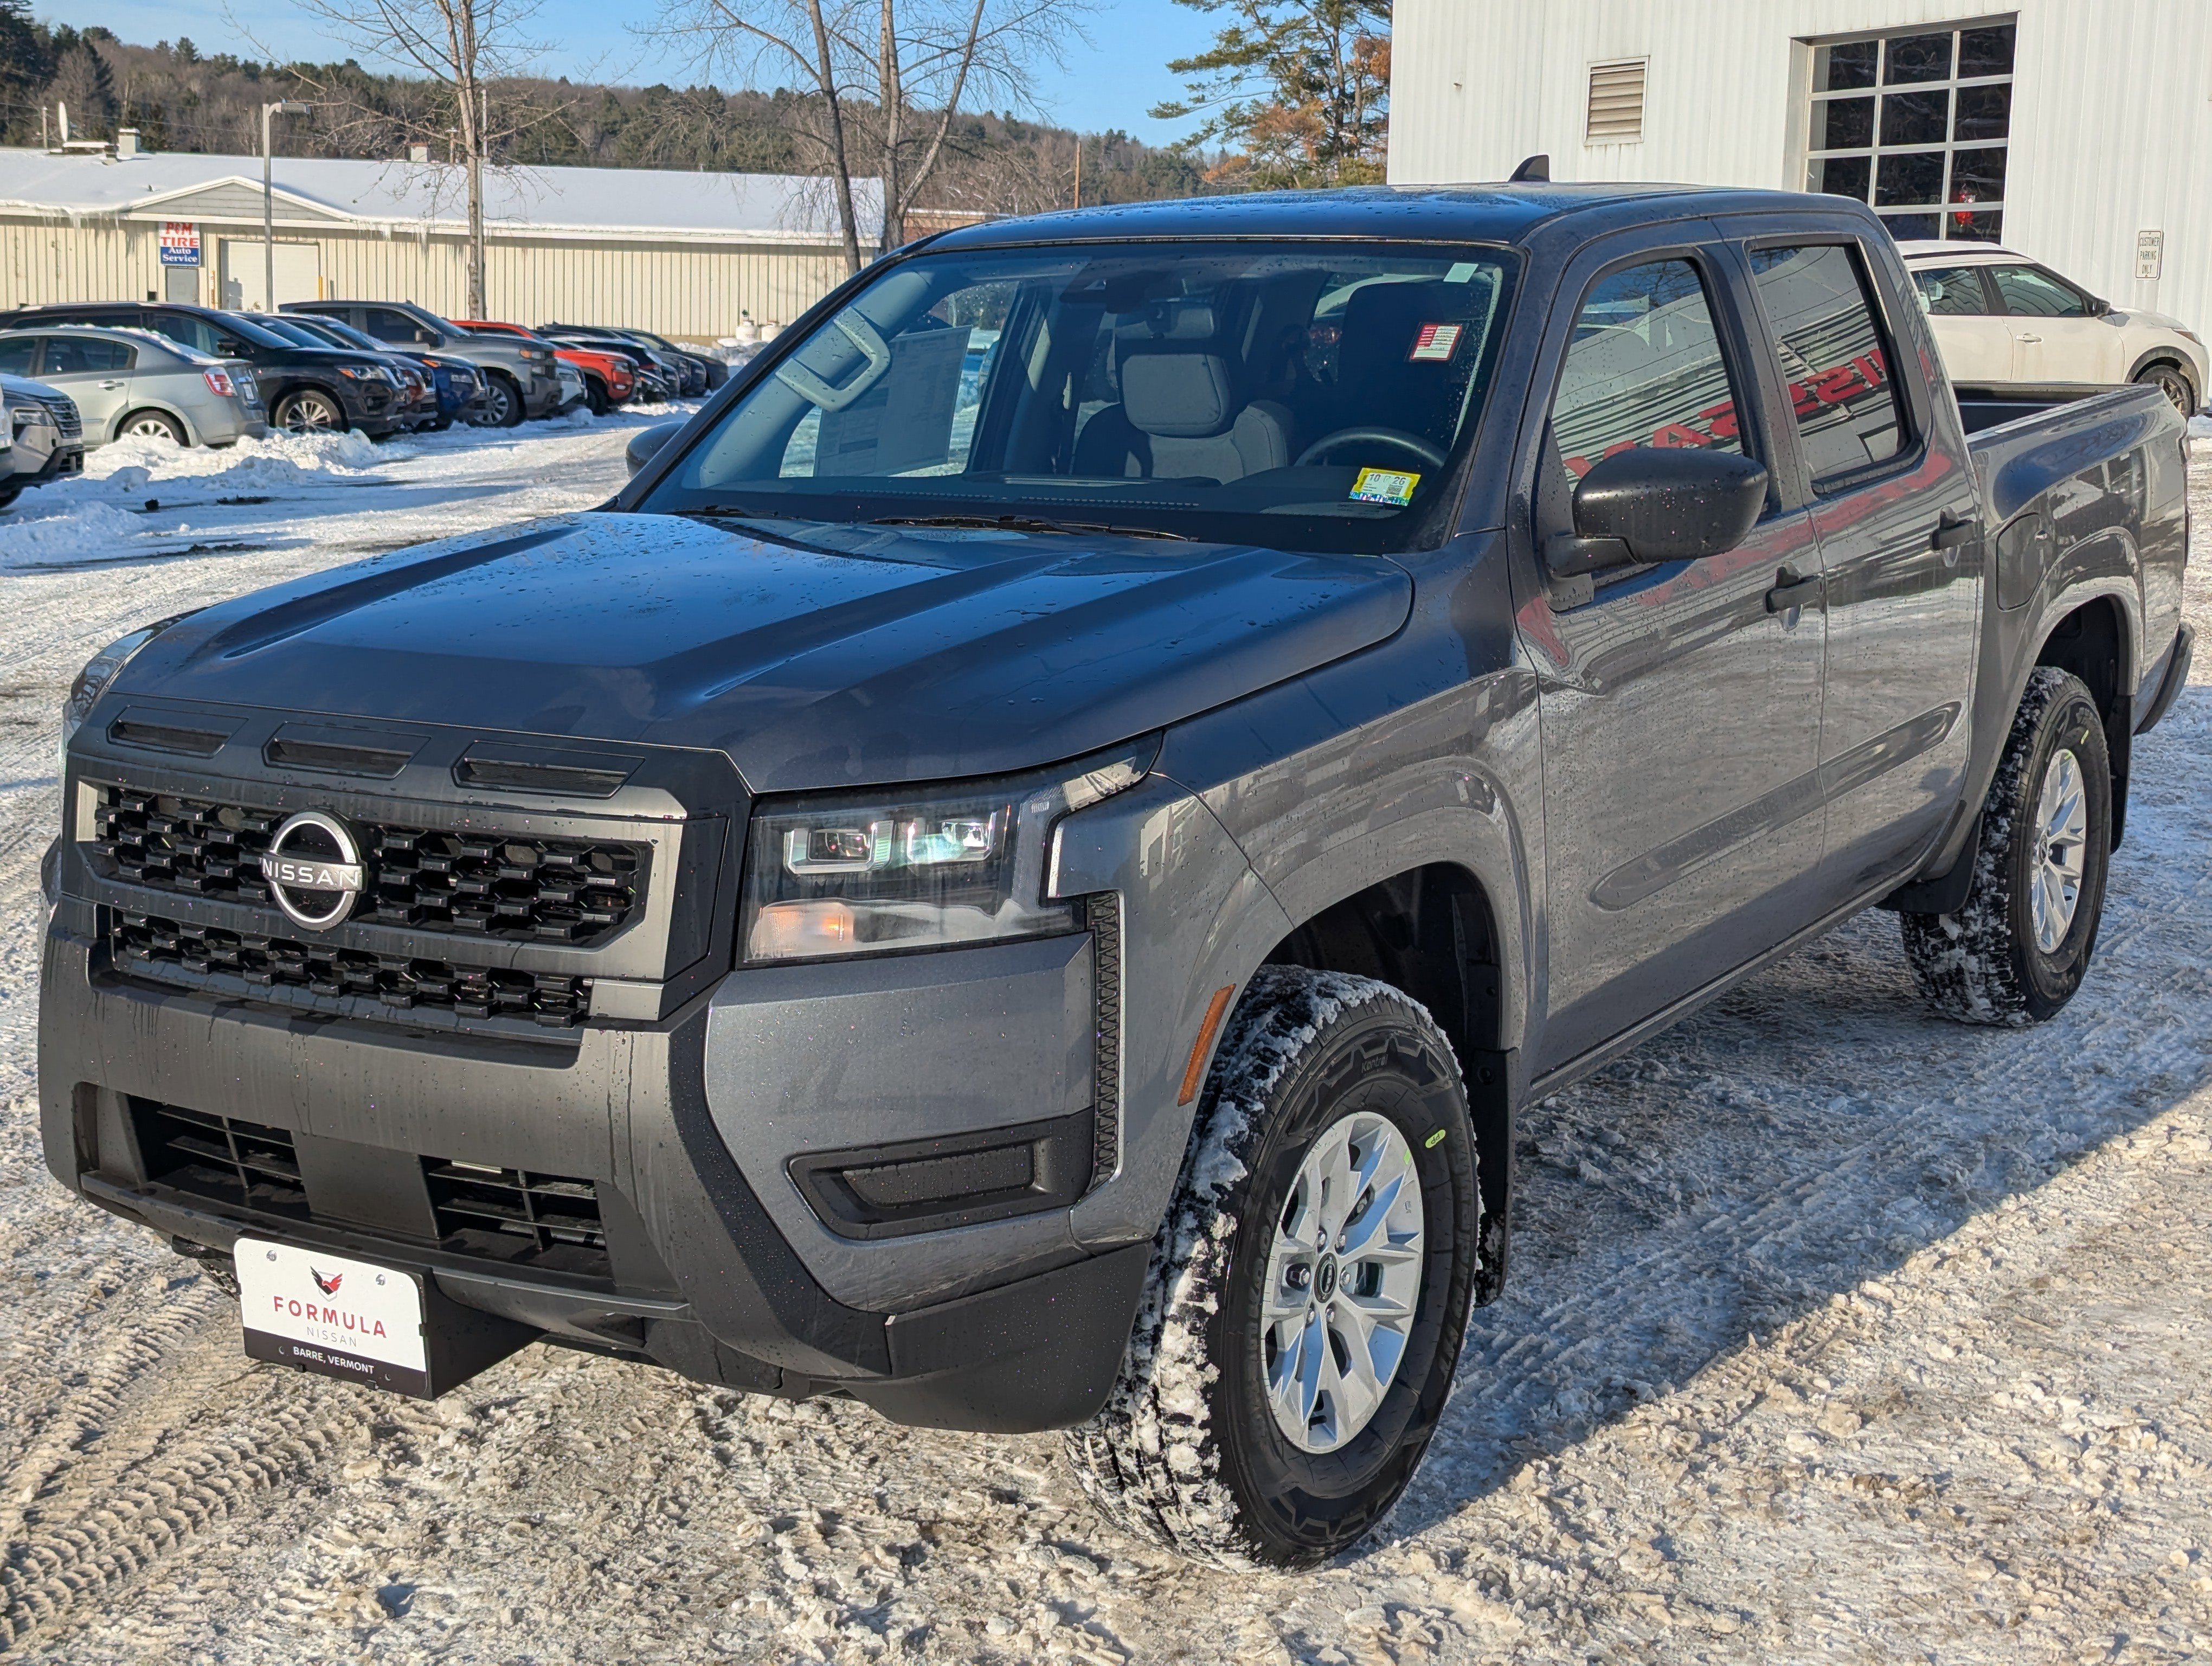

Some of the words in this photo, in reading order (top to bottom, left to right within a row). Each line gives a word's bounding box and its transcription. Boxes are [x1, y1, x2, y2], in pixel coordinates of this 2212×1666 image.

[160, 237, 199, 247] TIRE
[2139, 237, 2160, 247] CUSTOMER
[162, 254, 197, 262] Service
[2139, 251, 2157, 260] PARKING
[2142, 264, 2152, 274] ONLY
[1369, 473, 1381, 482] 10
[1392, 476, 1406, 485] 26
[261, 858, 358, 887] NISSAN
[273, 1296, 387, 1338] FORMULA
[306, 1327, 357, 1347] NISSAN
[293, 1346, 326, 1363] BARRE,
[326, 1355, 375, 1374] VERMONT
